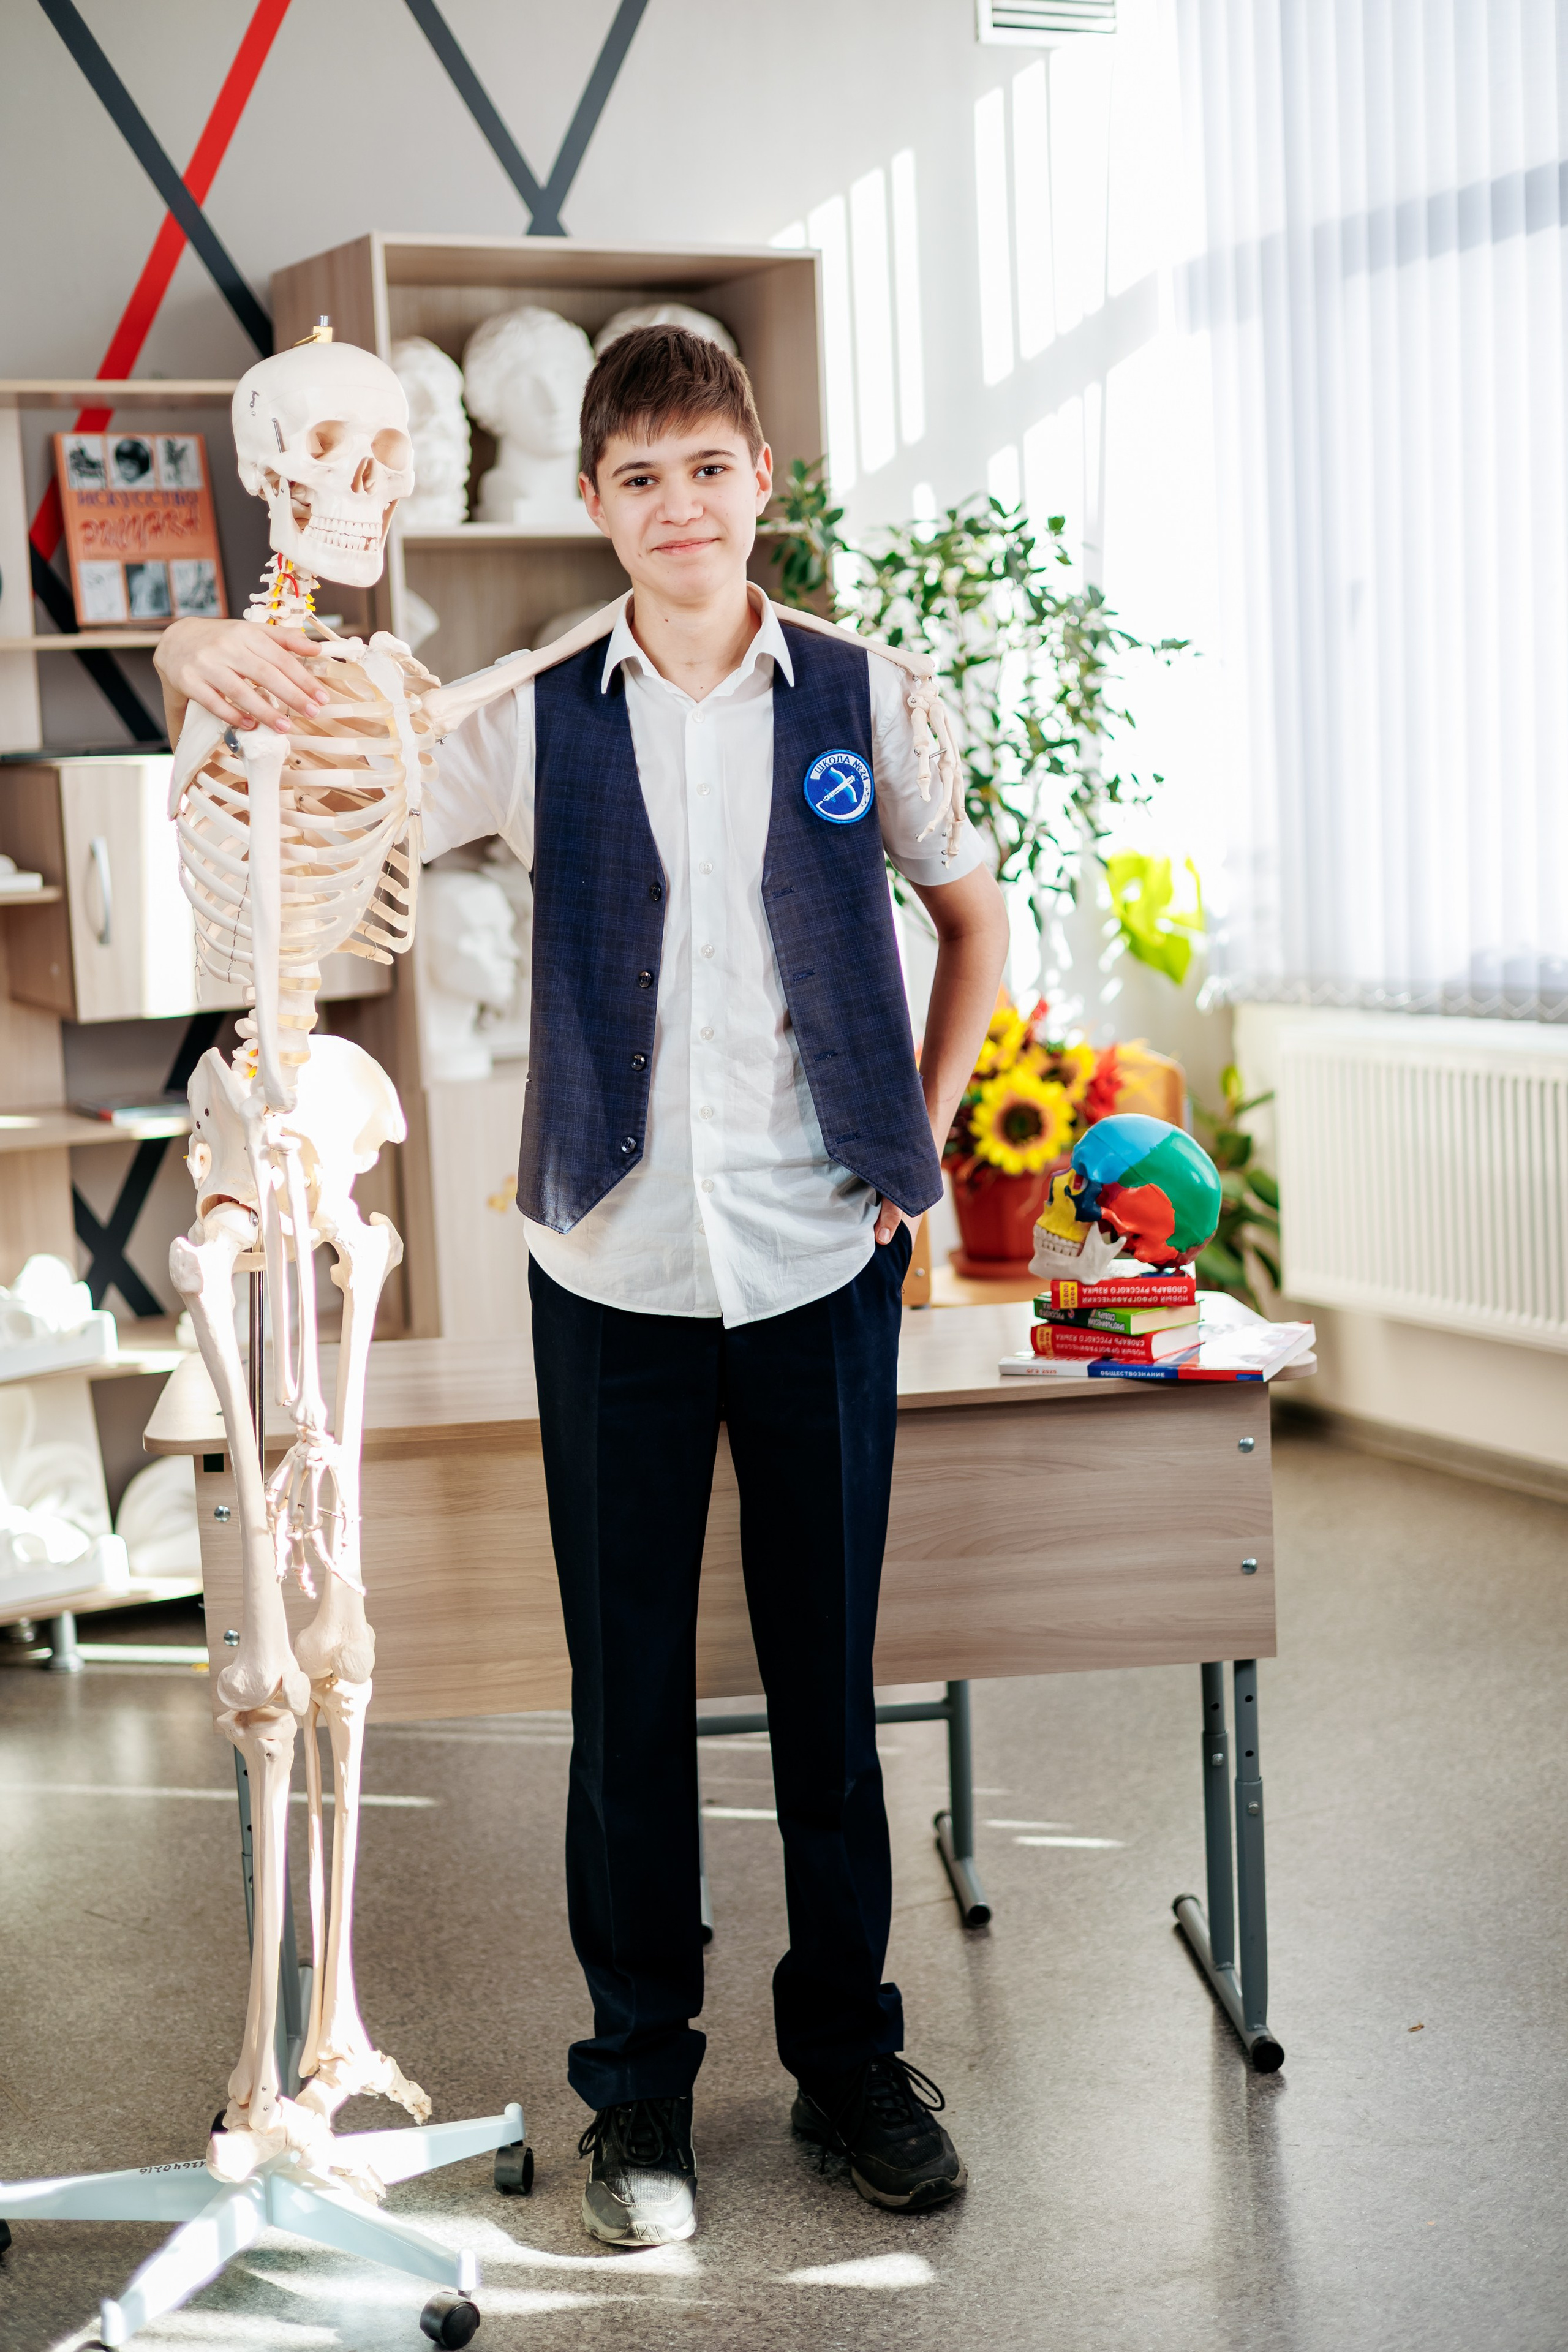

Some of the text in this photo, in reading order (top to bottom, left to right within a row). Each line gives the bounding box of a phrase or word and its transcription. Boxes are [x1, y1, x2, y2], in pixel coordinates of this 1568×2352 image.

[814, 755, 869, 781] ШКОЛА №24
[1110, 1286, 1149, 1295] РУССКОГО
[1152, 1286, 1188, 1294] СЛОВАРЬ
[1079, 1335, 1112, 1344] РУССКОГО
[1114, 1337, 1145, 1347] СЛОВАРЬ
